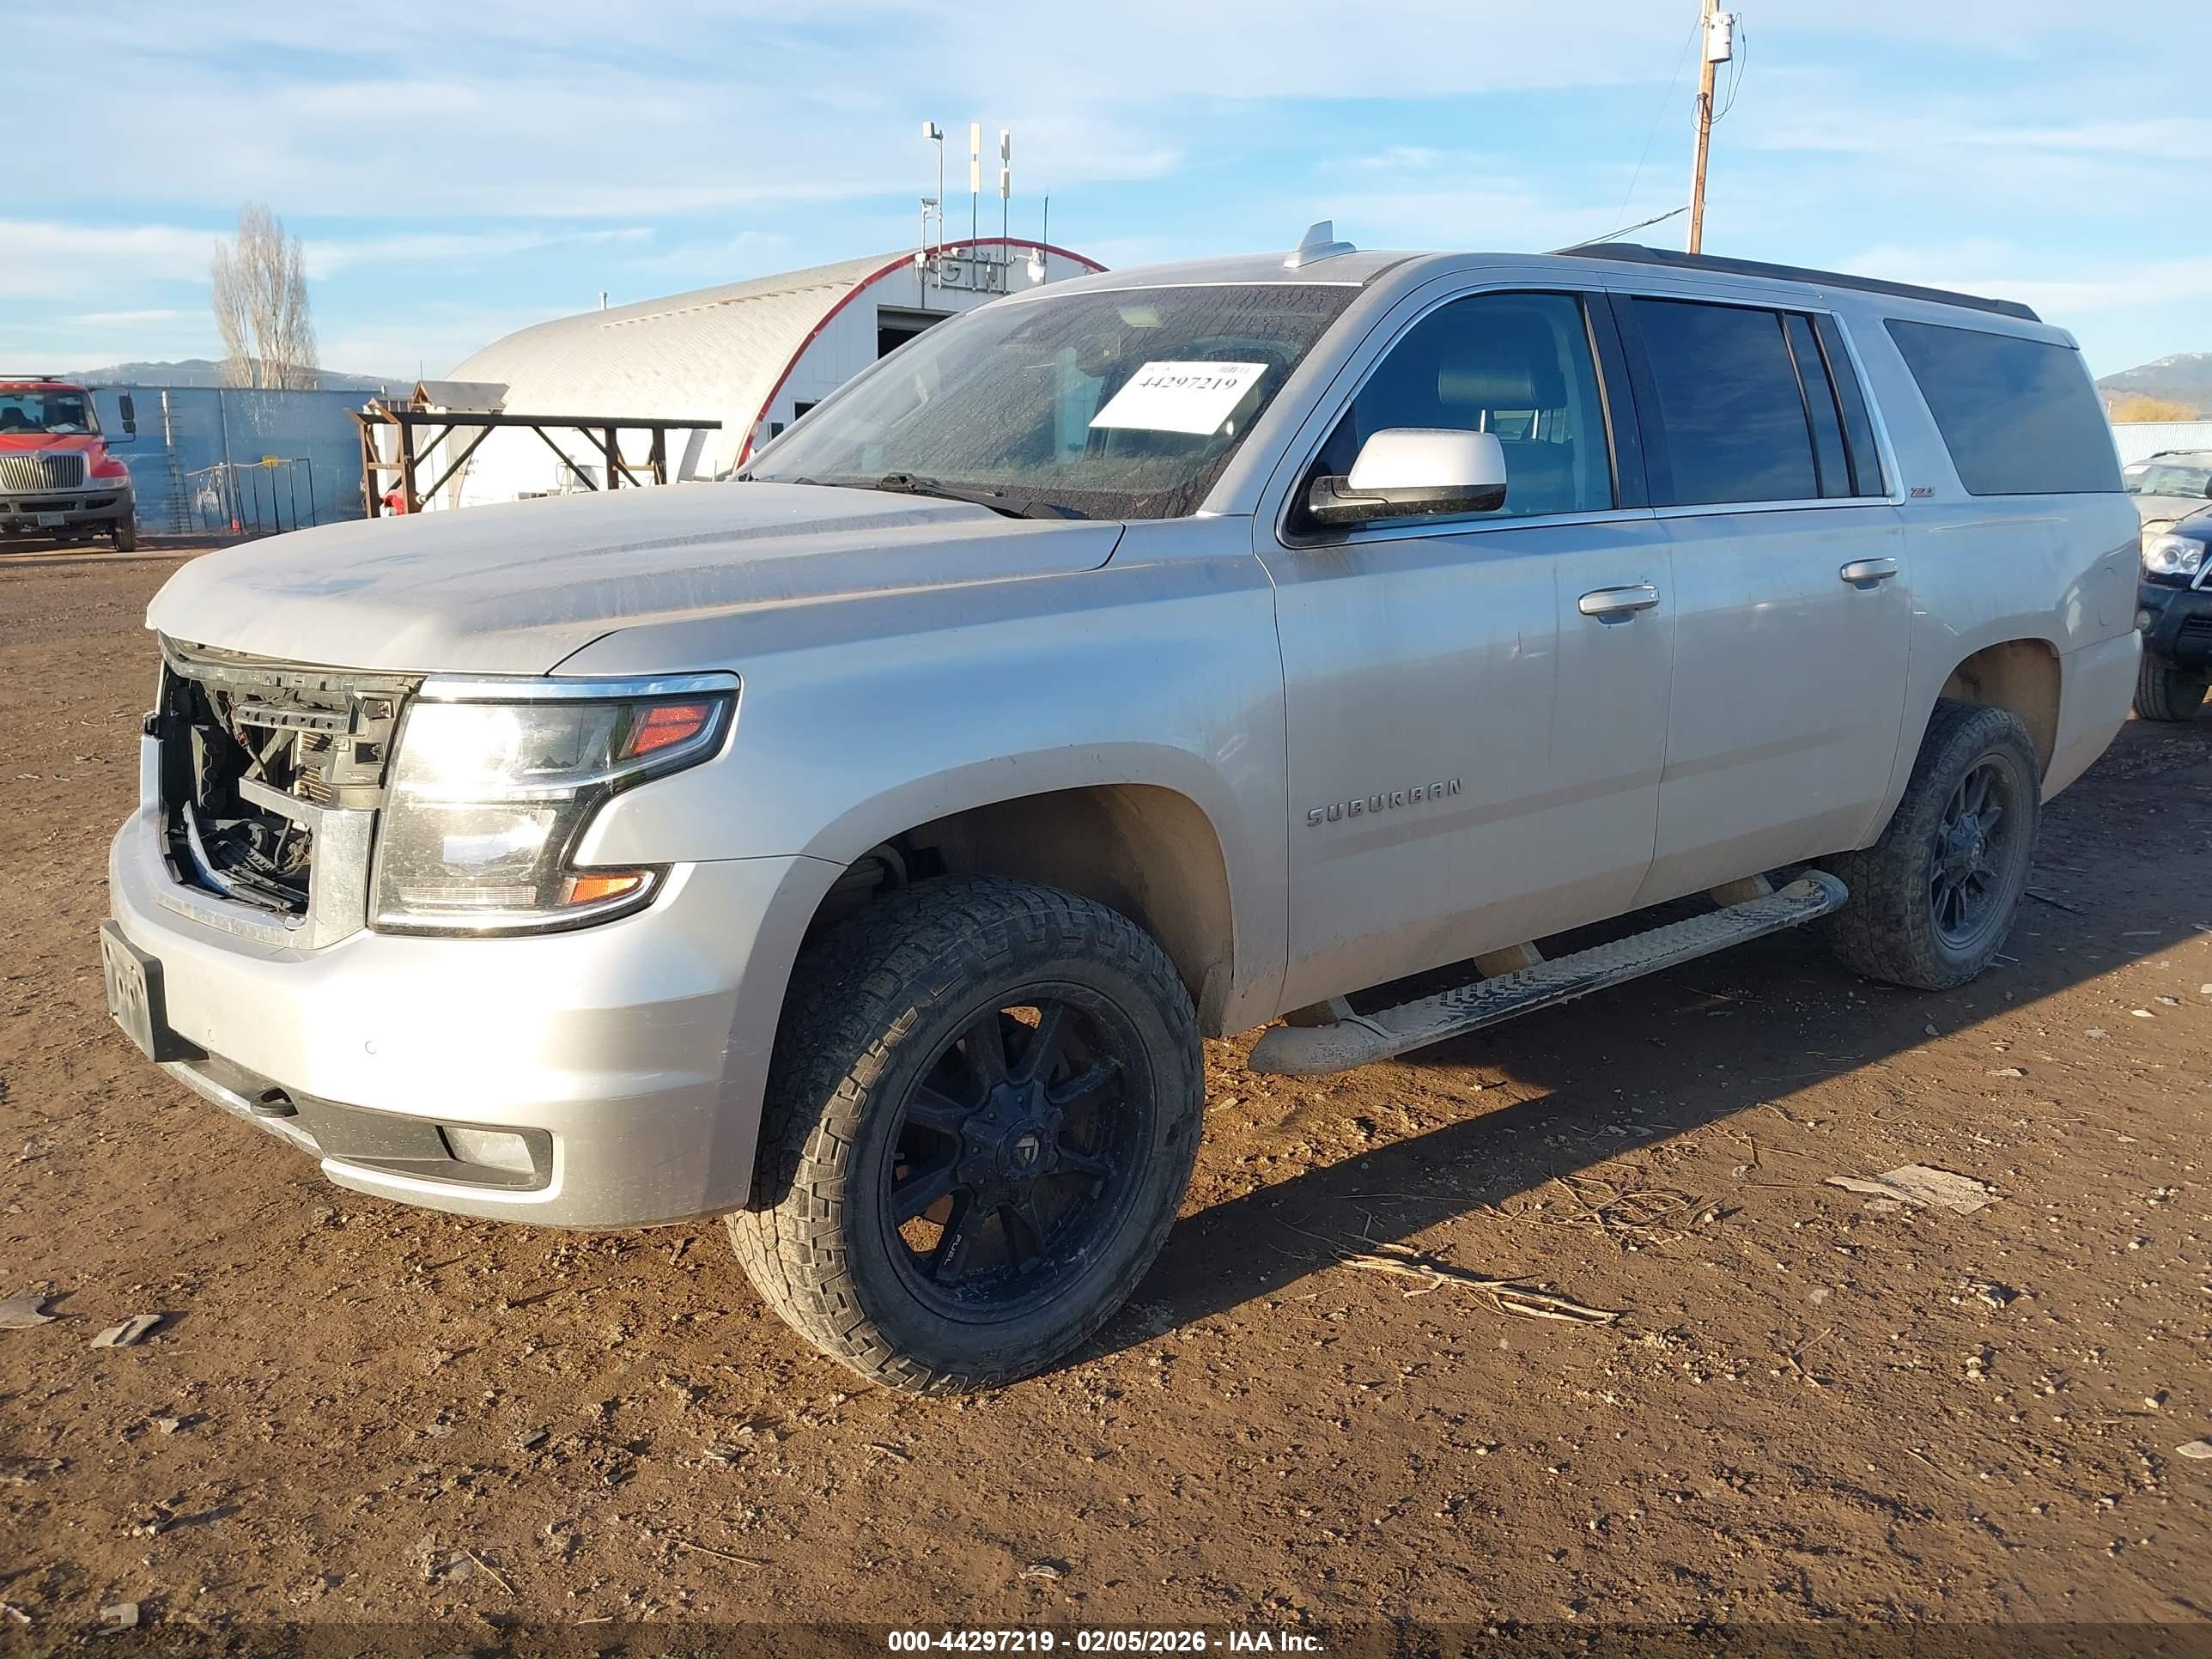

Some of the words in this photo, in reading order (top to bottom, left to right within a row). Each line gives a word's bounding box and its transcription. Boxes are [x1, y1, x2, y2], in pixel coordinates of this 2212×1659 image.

[1139, 375, 1237, 390] 44297219
[1306, 778, 1463, 828] SUBURBAN
[942, 1233, 963, 1267] FUEL
